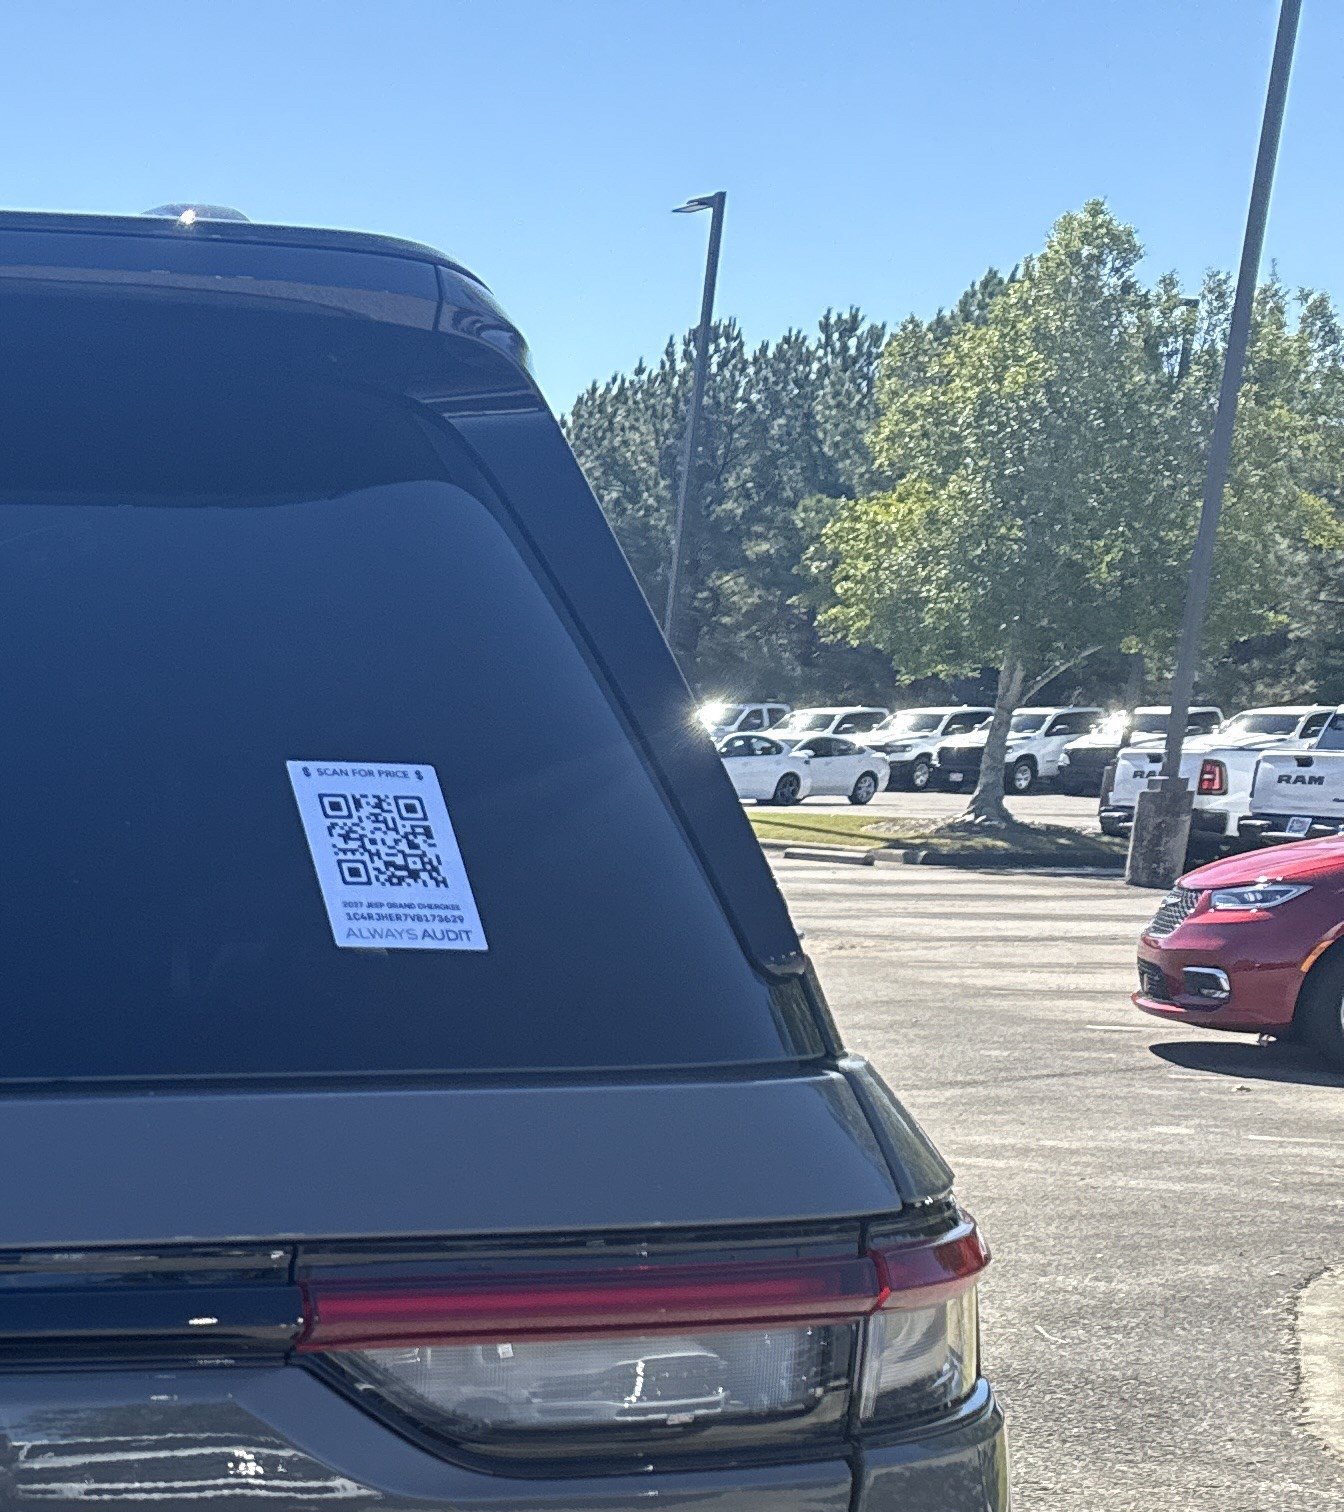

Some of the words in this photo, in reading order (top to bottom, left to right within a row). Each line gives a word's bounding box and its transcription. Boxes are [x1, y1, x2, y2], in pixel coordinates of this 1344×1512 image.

[316, 767, 350, 777] SCAN
[352, 768, 375, 778] FOR
[377, 769, 410, 779] PRICE
[1277, 774, 1326, 786] RAM
[366, 901, 385, 909] JEEP
[386, 902, 416, 910] GRAND
[417, 903, 461, 911] CHEROKEE
[346, 927, 419, 941] ALWAYS
[421, 928, 472, 942] AUDIT
